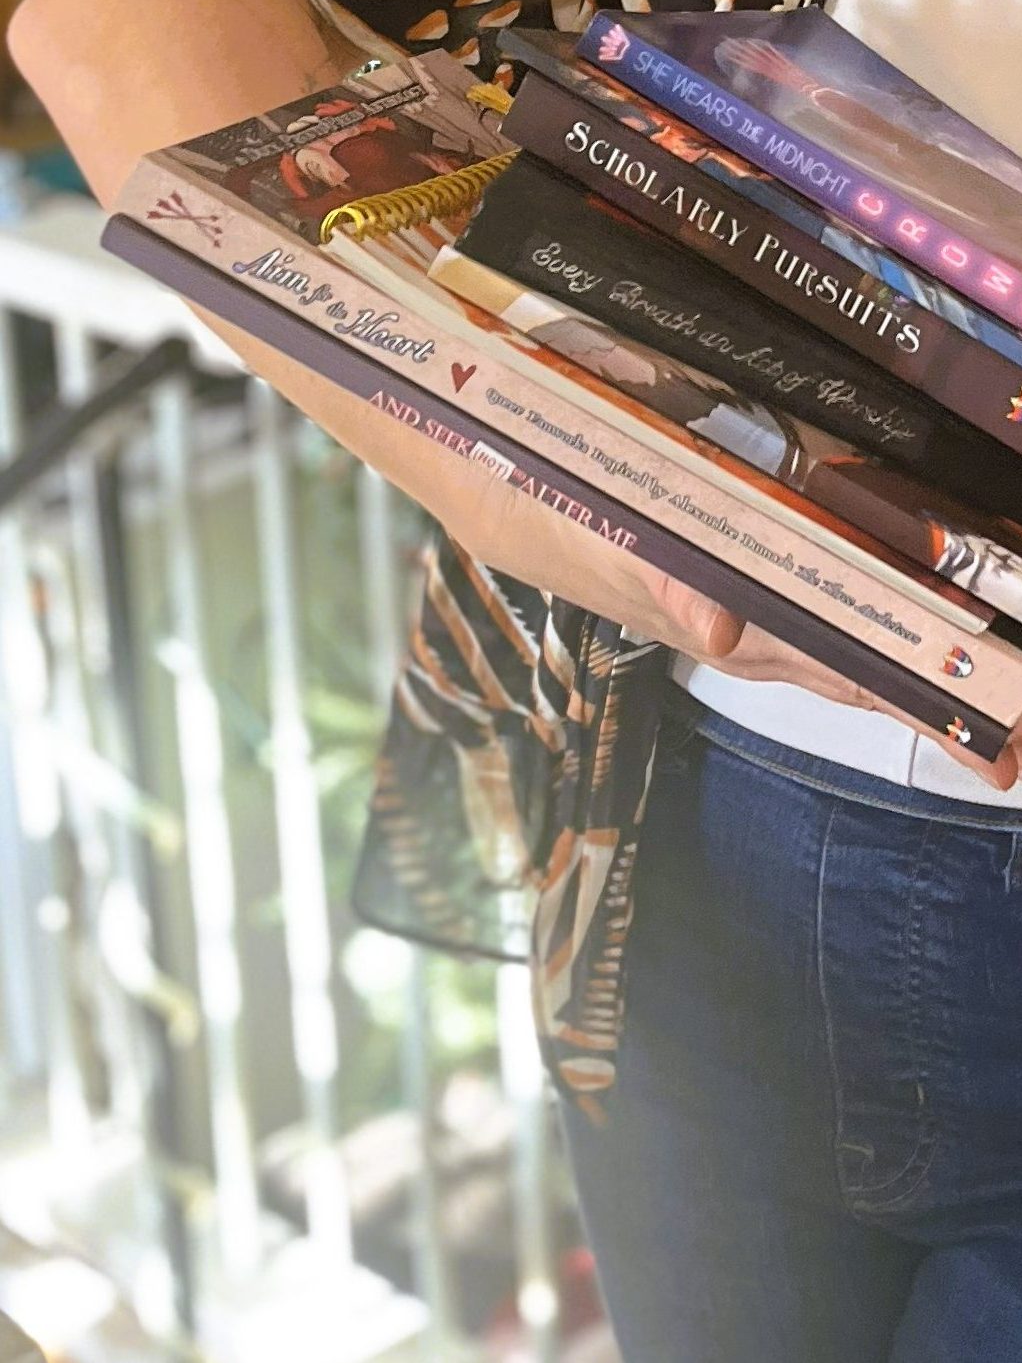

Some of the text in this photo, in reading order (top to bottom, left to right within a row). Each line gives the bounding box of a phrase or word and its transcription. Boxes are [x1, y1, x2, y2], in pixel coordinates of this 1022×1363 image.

[632, 51, 673, 85] SHE
[673, 73, 738, 128] WEARS
[764, 133, 851, 197] MIDNIGHT
[232, 247, 312, 296] Aim
[333, 307, 436, 364] Heart
[532, 242, 603, 293] Every
[608, 280, 702, 336] Breath
[565, 120, 749, 248] SCHOLARLY
[753, 233, 922, 355] PURSUITS
[367, 389, 422, 429] AND
[421, 417, 476, 456] SEEK
[518, 476, 594, 528] ALTER
[597, 518, 639, 553] ME
